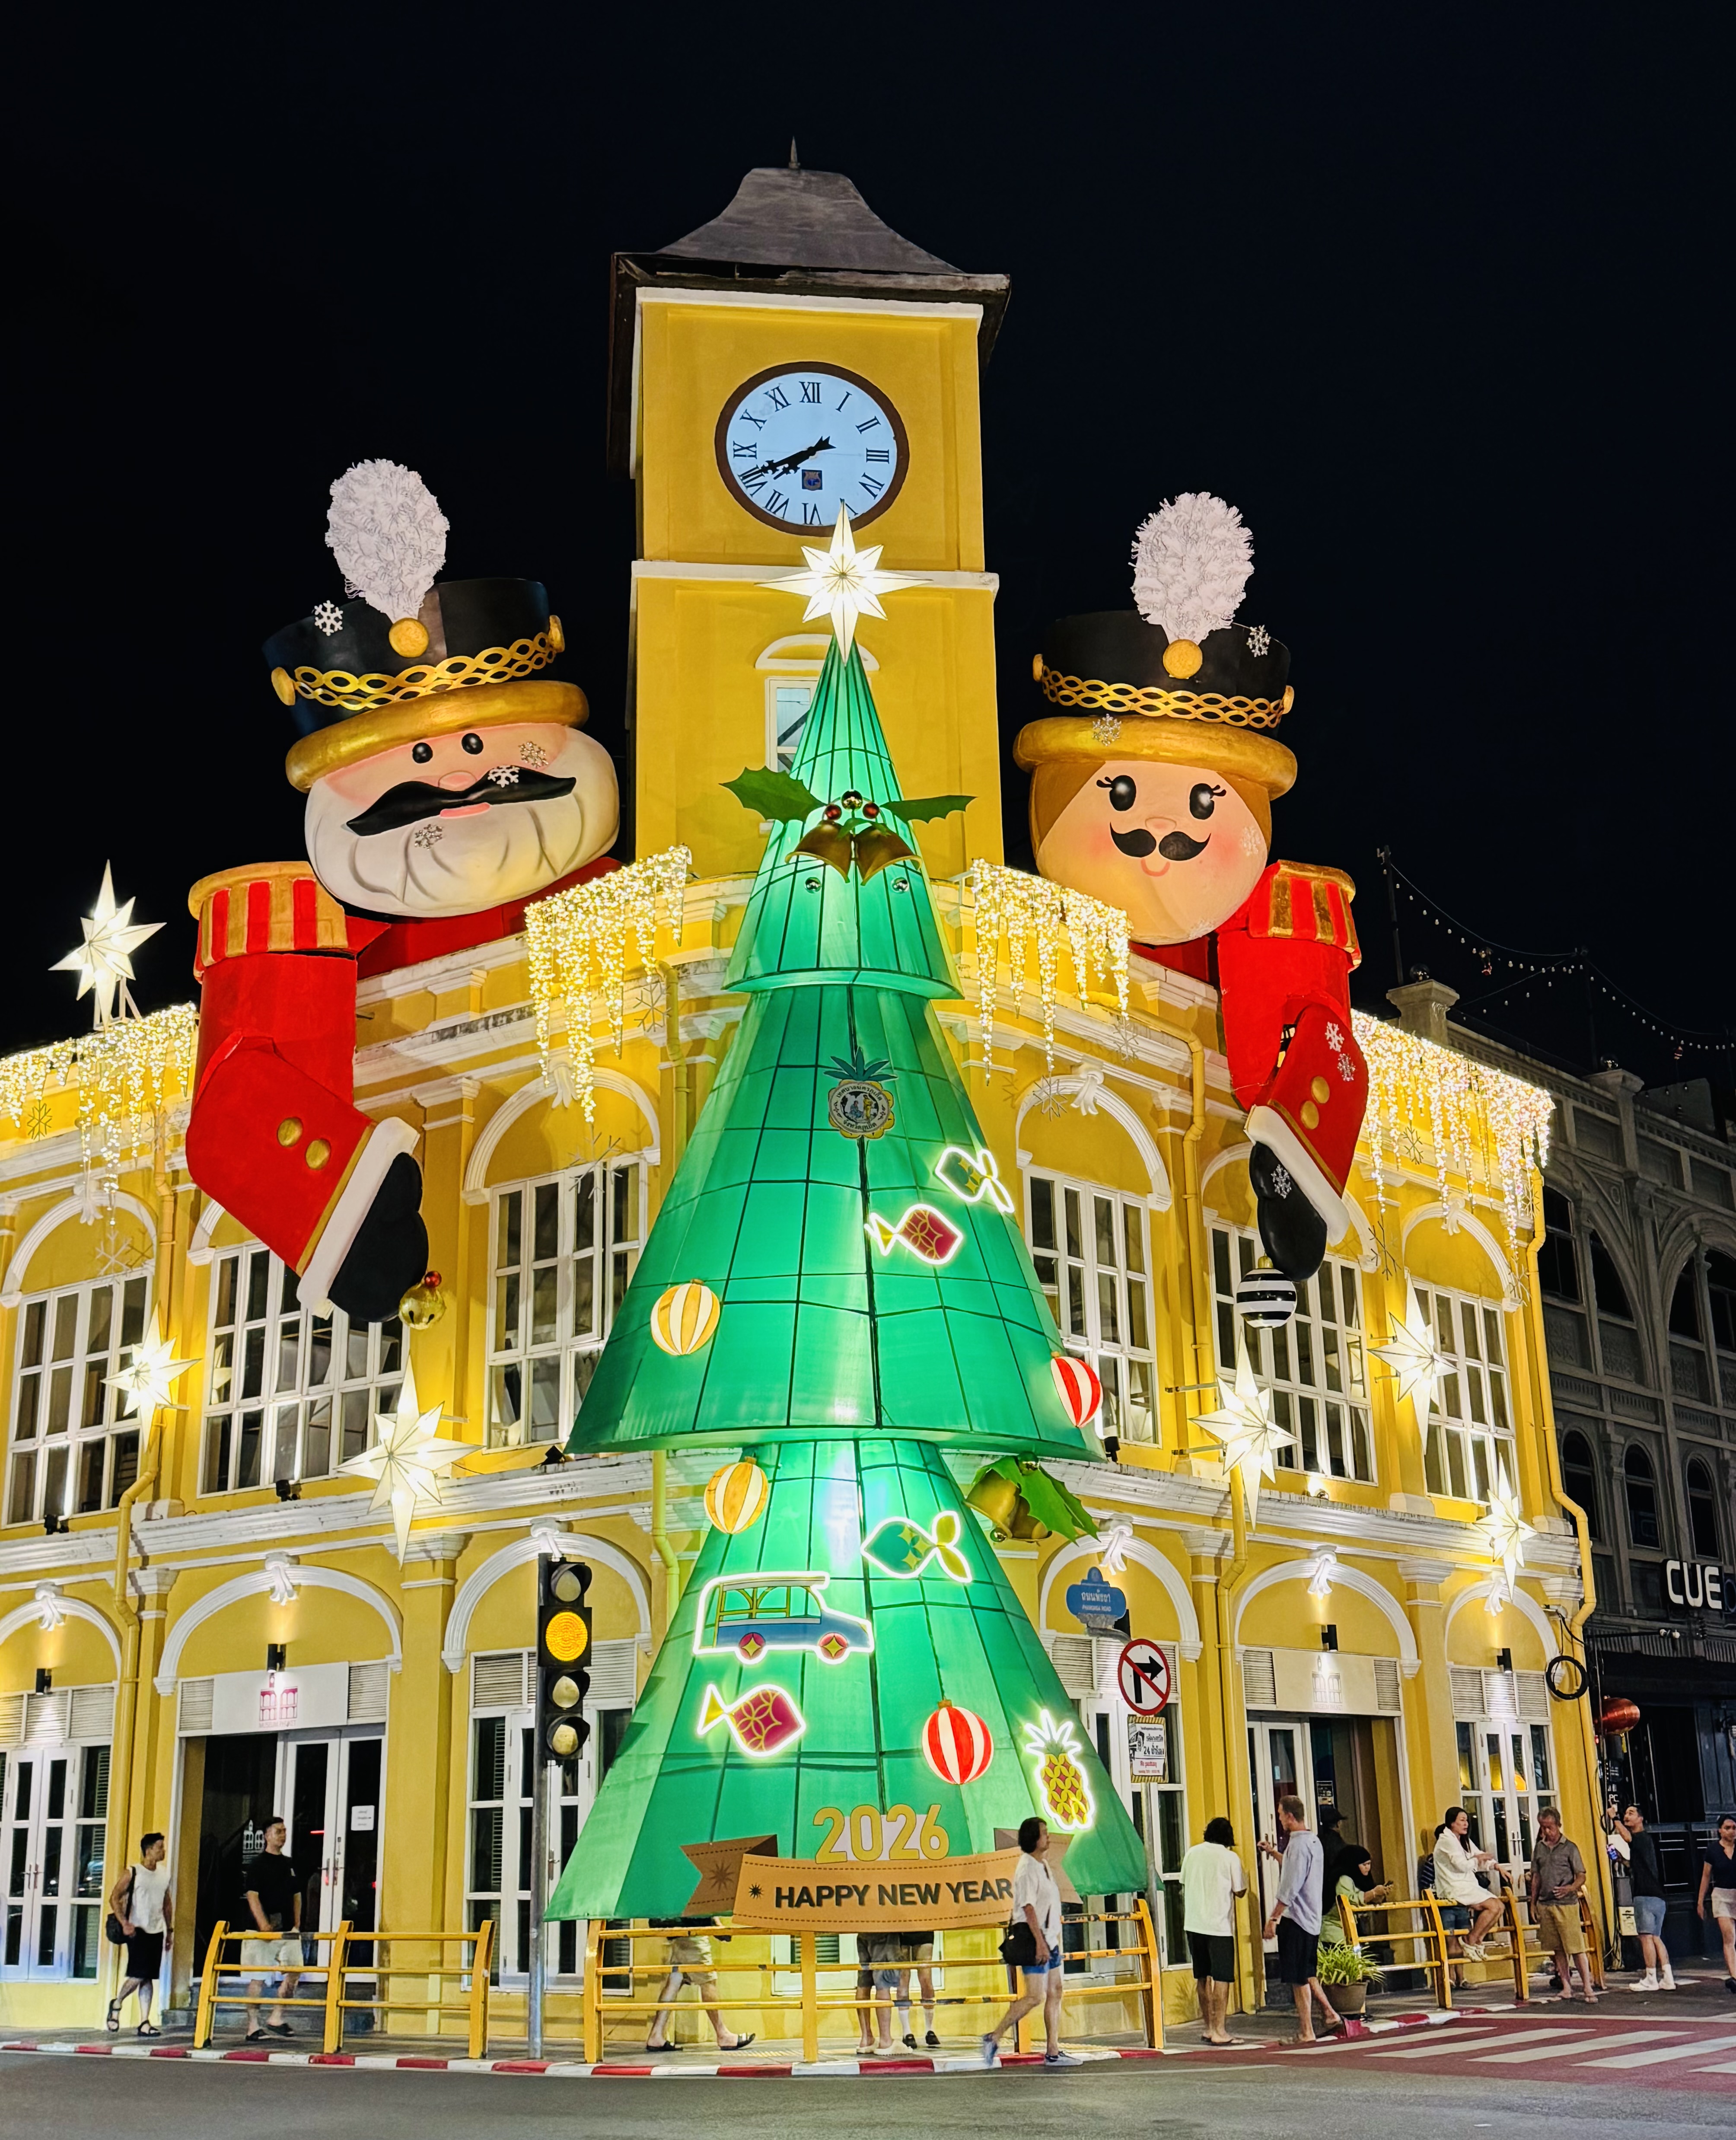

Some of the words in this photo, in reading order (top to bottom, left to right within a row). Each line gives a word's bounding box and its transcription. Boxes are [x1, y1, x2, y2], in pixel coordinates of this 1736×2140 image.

[763, 385, 791, 412] XI
[799, 381, 822, 404] XII
[836, 391, 852, 412] I
[740, 409, 767, 431] X
[855, 416, 881, 434] II
[733, 441, 757, 459] IX
[866, 448, 889, 464] III
[859, 472, 885, 500] IV
[763, 489, 790, 519] VII
[802, 503, 823, 525] VI
[1666, 1560, 1722, 1609] CUE
[1144, 1746, 1150, 1754] 24
[813, 1804, 949, 1864] 2026
[775, 1884, 870, 1909] HAPPY
[878, 1882, 940, 1906] NEW
[946, 1878, 1014, 1903] YEAR
